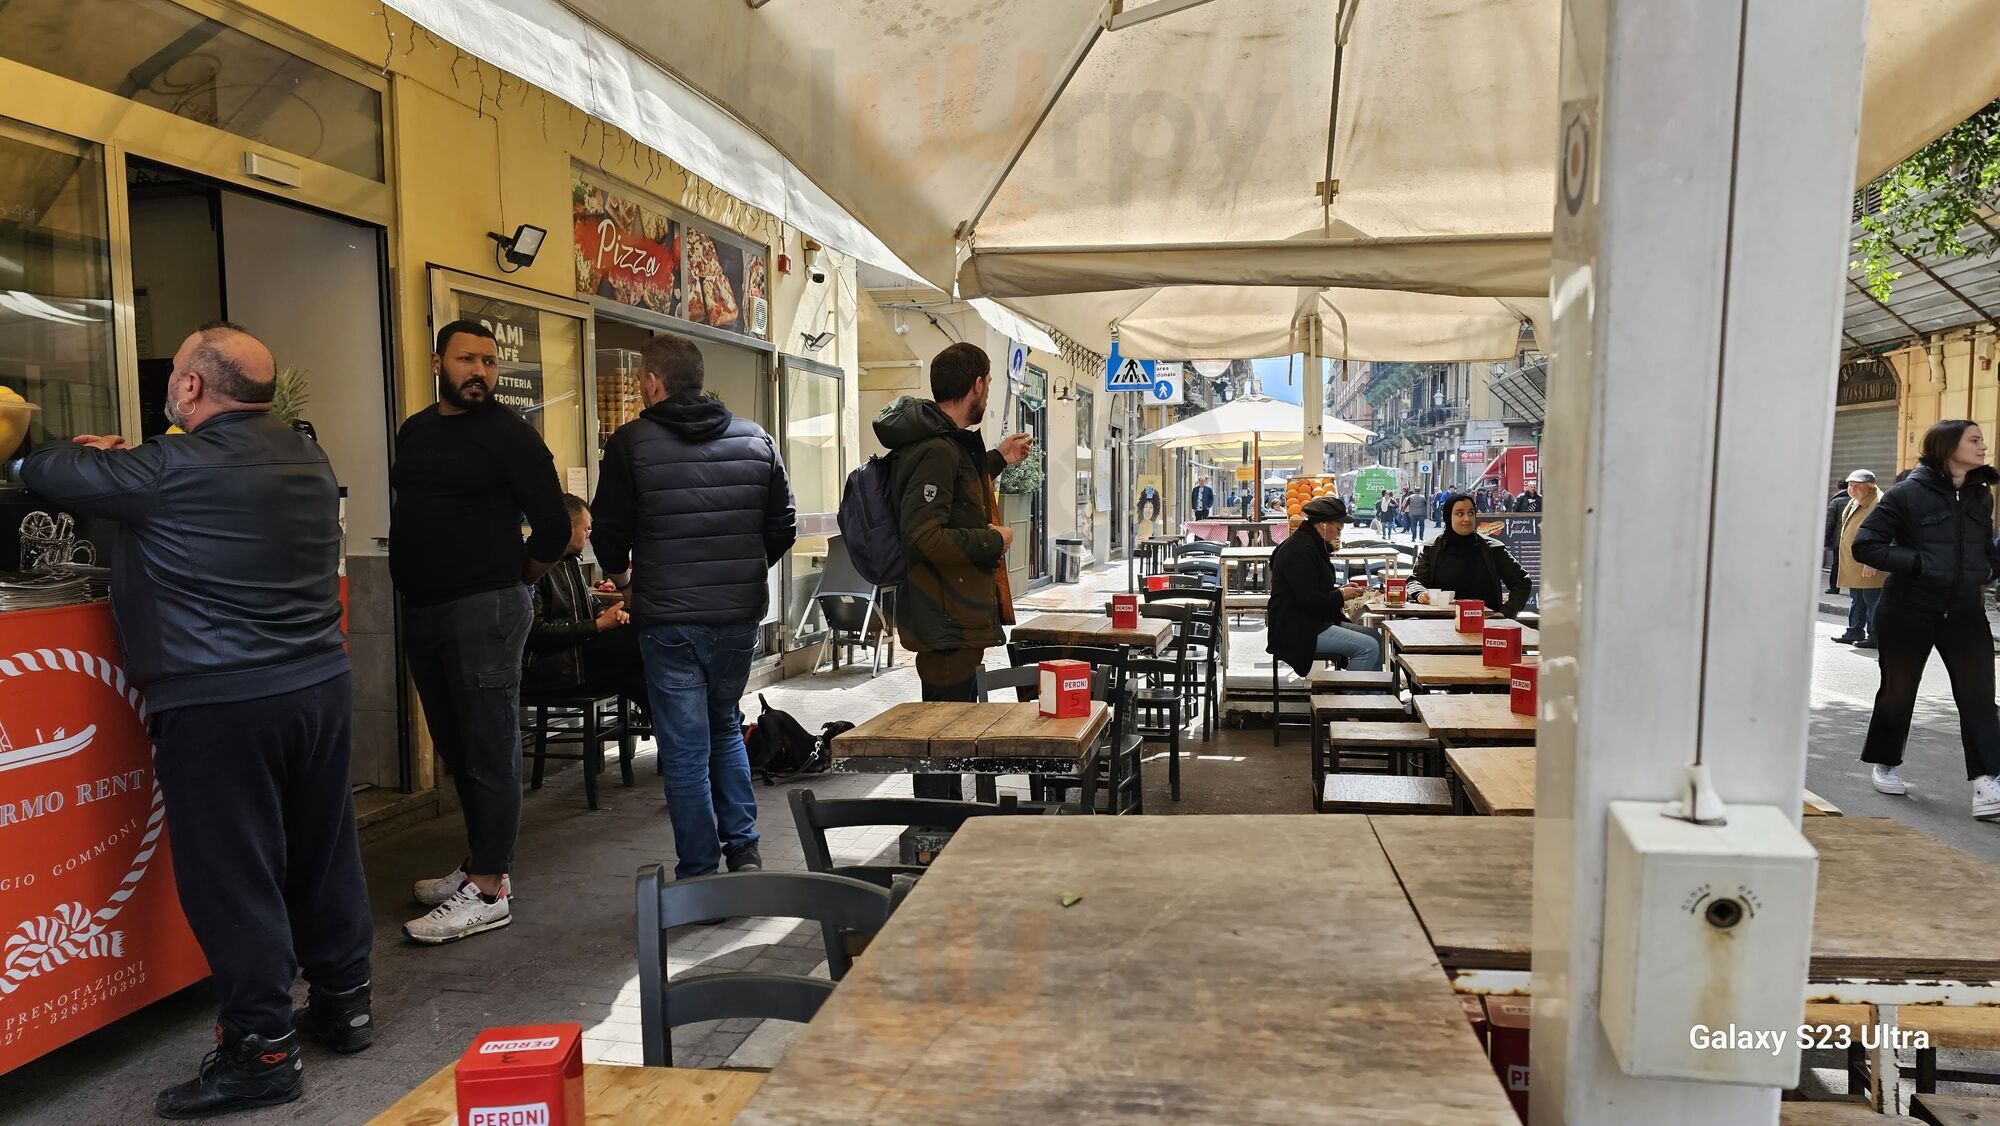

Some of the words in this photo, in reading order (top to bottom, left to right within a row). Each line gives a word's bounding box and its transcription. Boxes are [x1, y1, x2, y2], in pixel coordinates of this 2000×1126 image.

[597, 218, 661, 277] Pizza
[1064, 680, 1087, 689] PERONI
[1512, 680, 1531, 690] PERONI
[0, 791, 64, 827] RMO
[75, 769, 145, 806] RENT
[0, 873, 35, 891] GIO
[52, 818, 138, 876] GOMMONI
[5, 1027, 24, 1045] 27
[50, 973, 146, 1025] 3285540393
[6, 960, 143, 1030] PRENOTAZIONI
[485, 1039, 555, 1052] PERONI
[473, 1108, 545, 1126] PERONI
